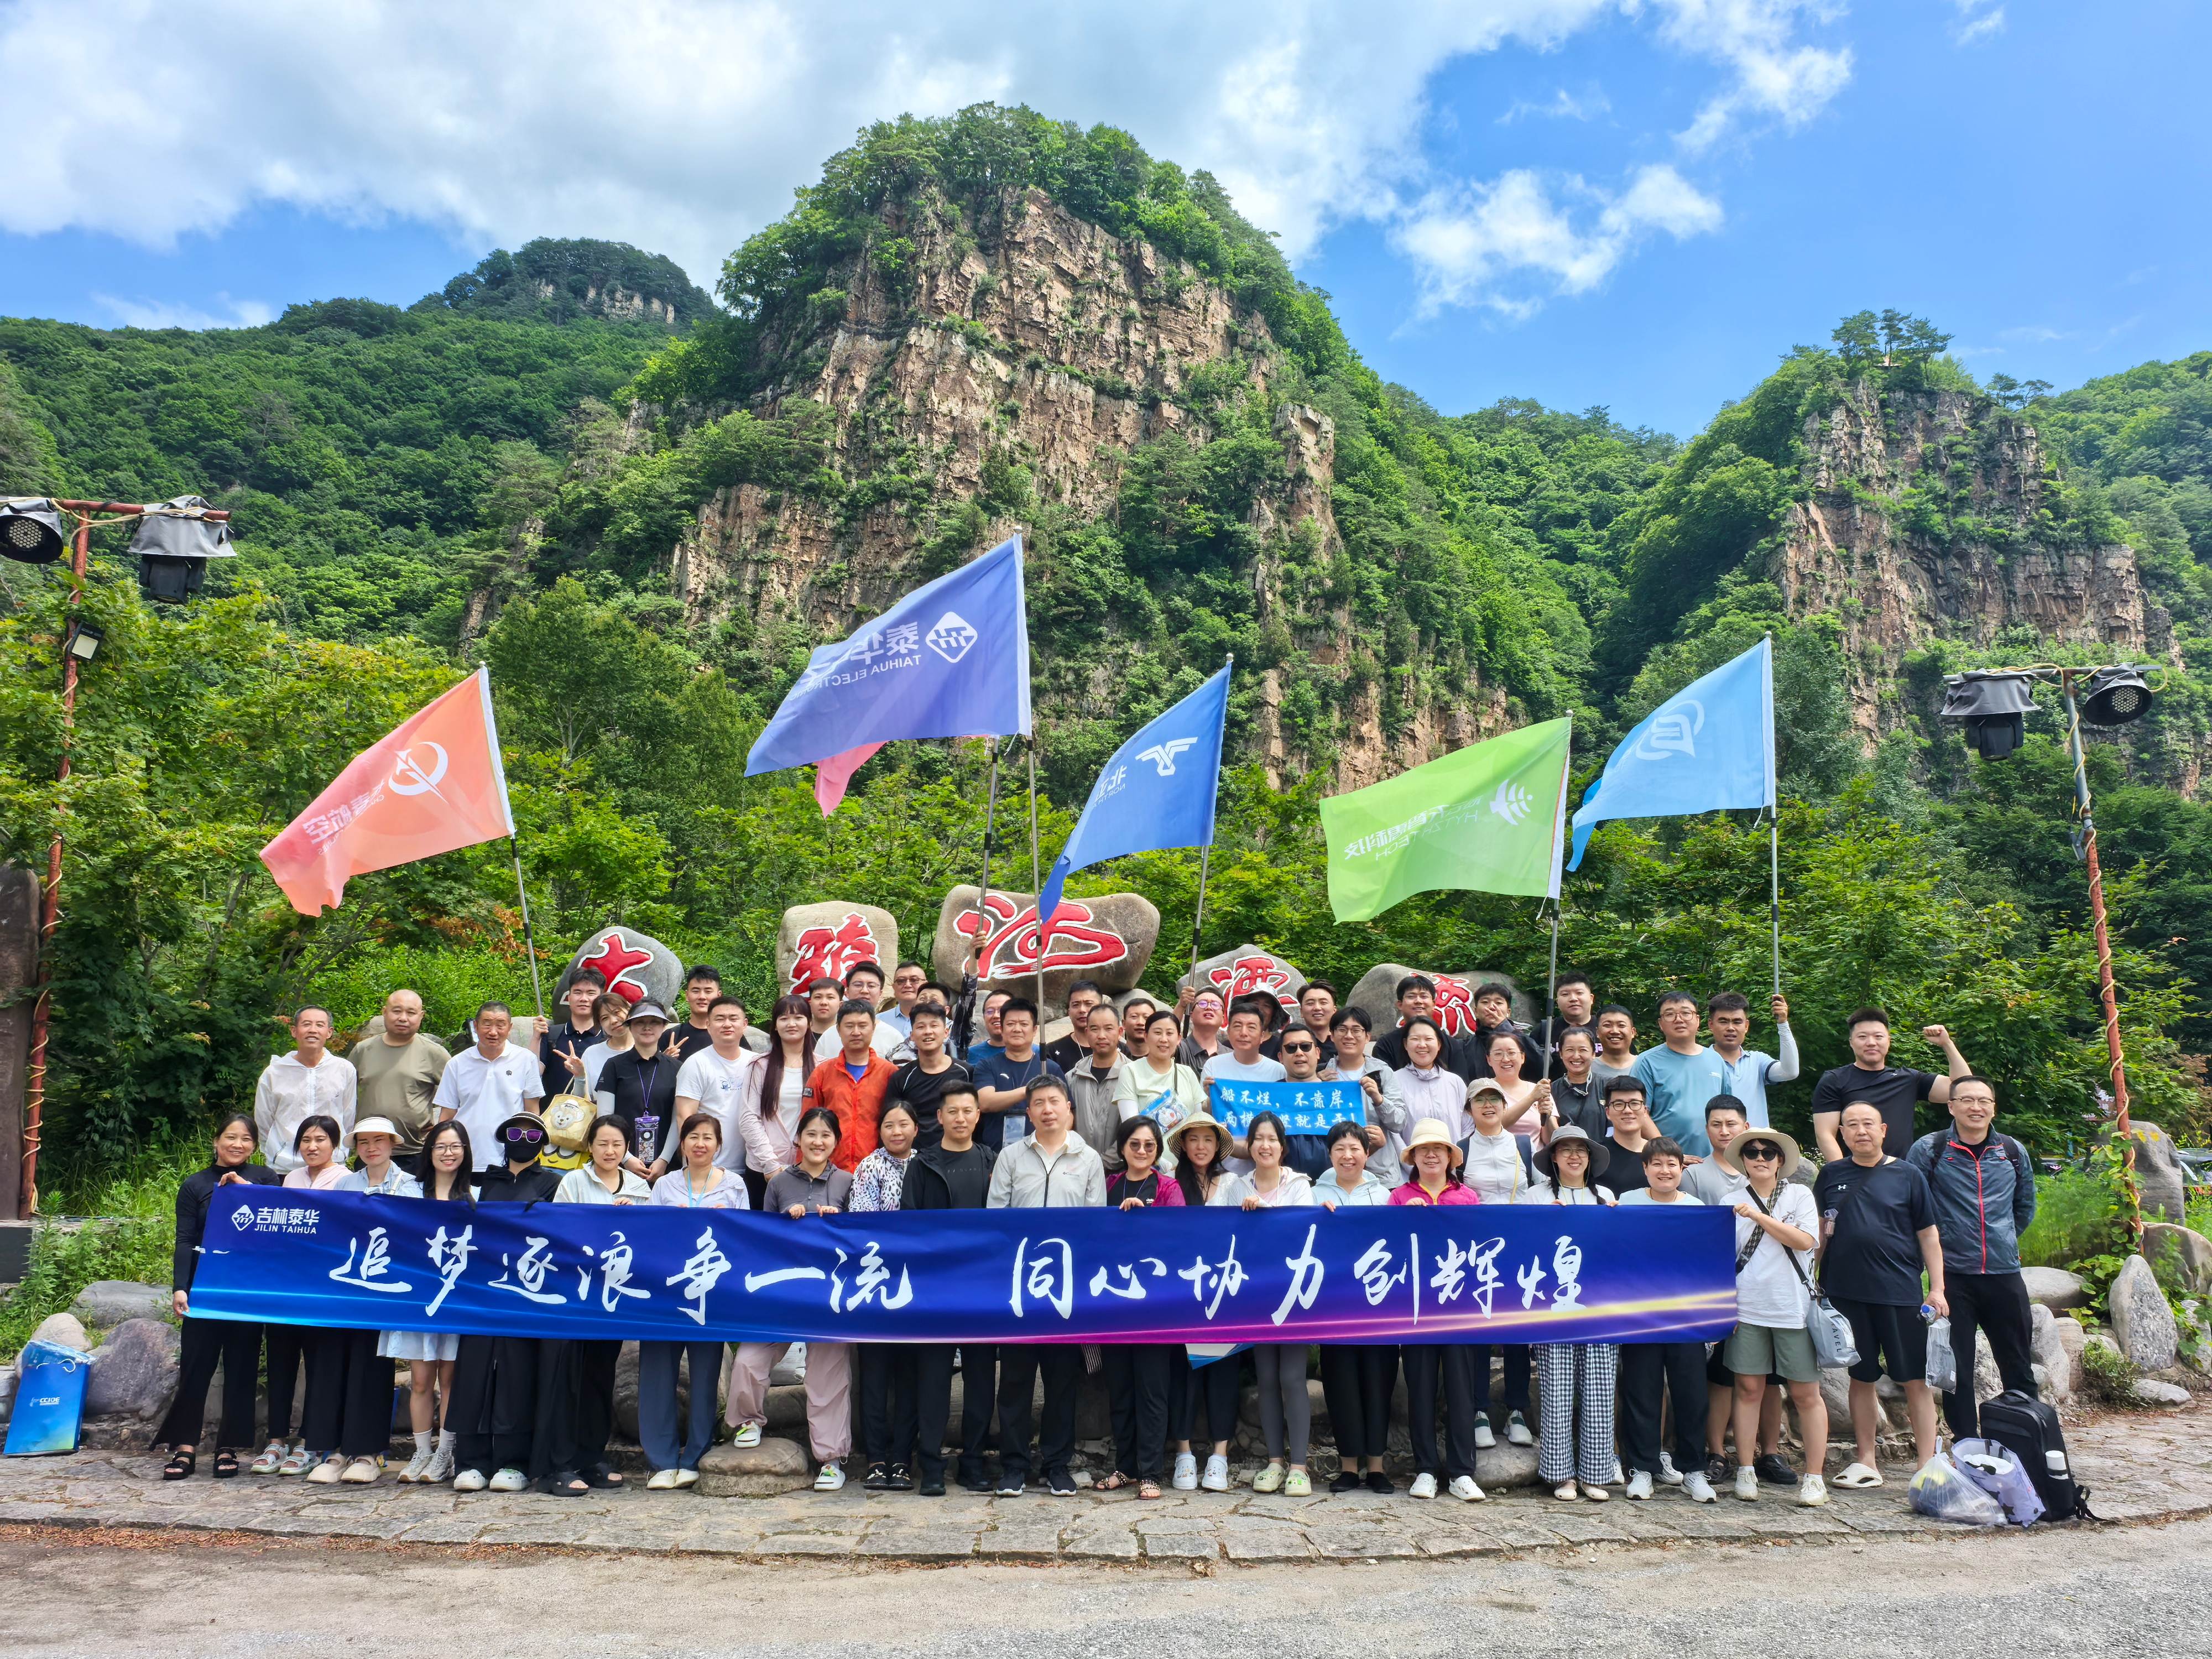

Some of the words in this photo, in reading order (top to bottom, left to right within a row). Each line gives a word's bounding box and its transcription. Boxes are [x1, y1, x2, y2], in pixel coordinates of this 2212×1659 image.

[256, 1207, 320, 1226] 吉林泰华
[254, 1224, 279, 1232] JILIN
[281, 1225, 317, 1234] TAIHUA
[329, 1225, 914, 1326] 追梦逐浪争一流
[1009, 1223, 1588, 1327] 同心协力创辉煌
